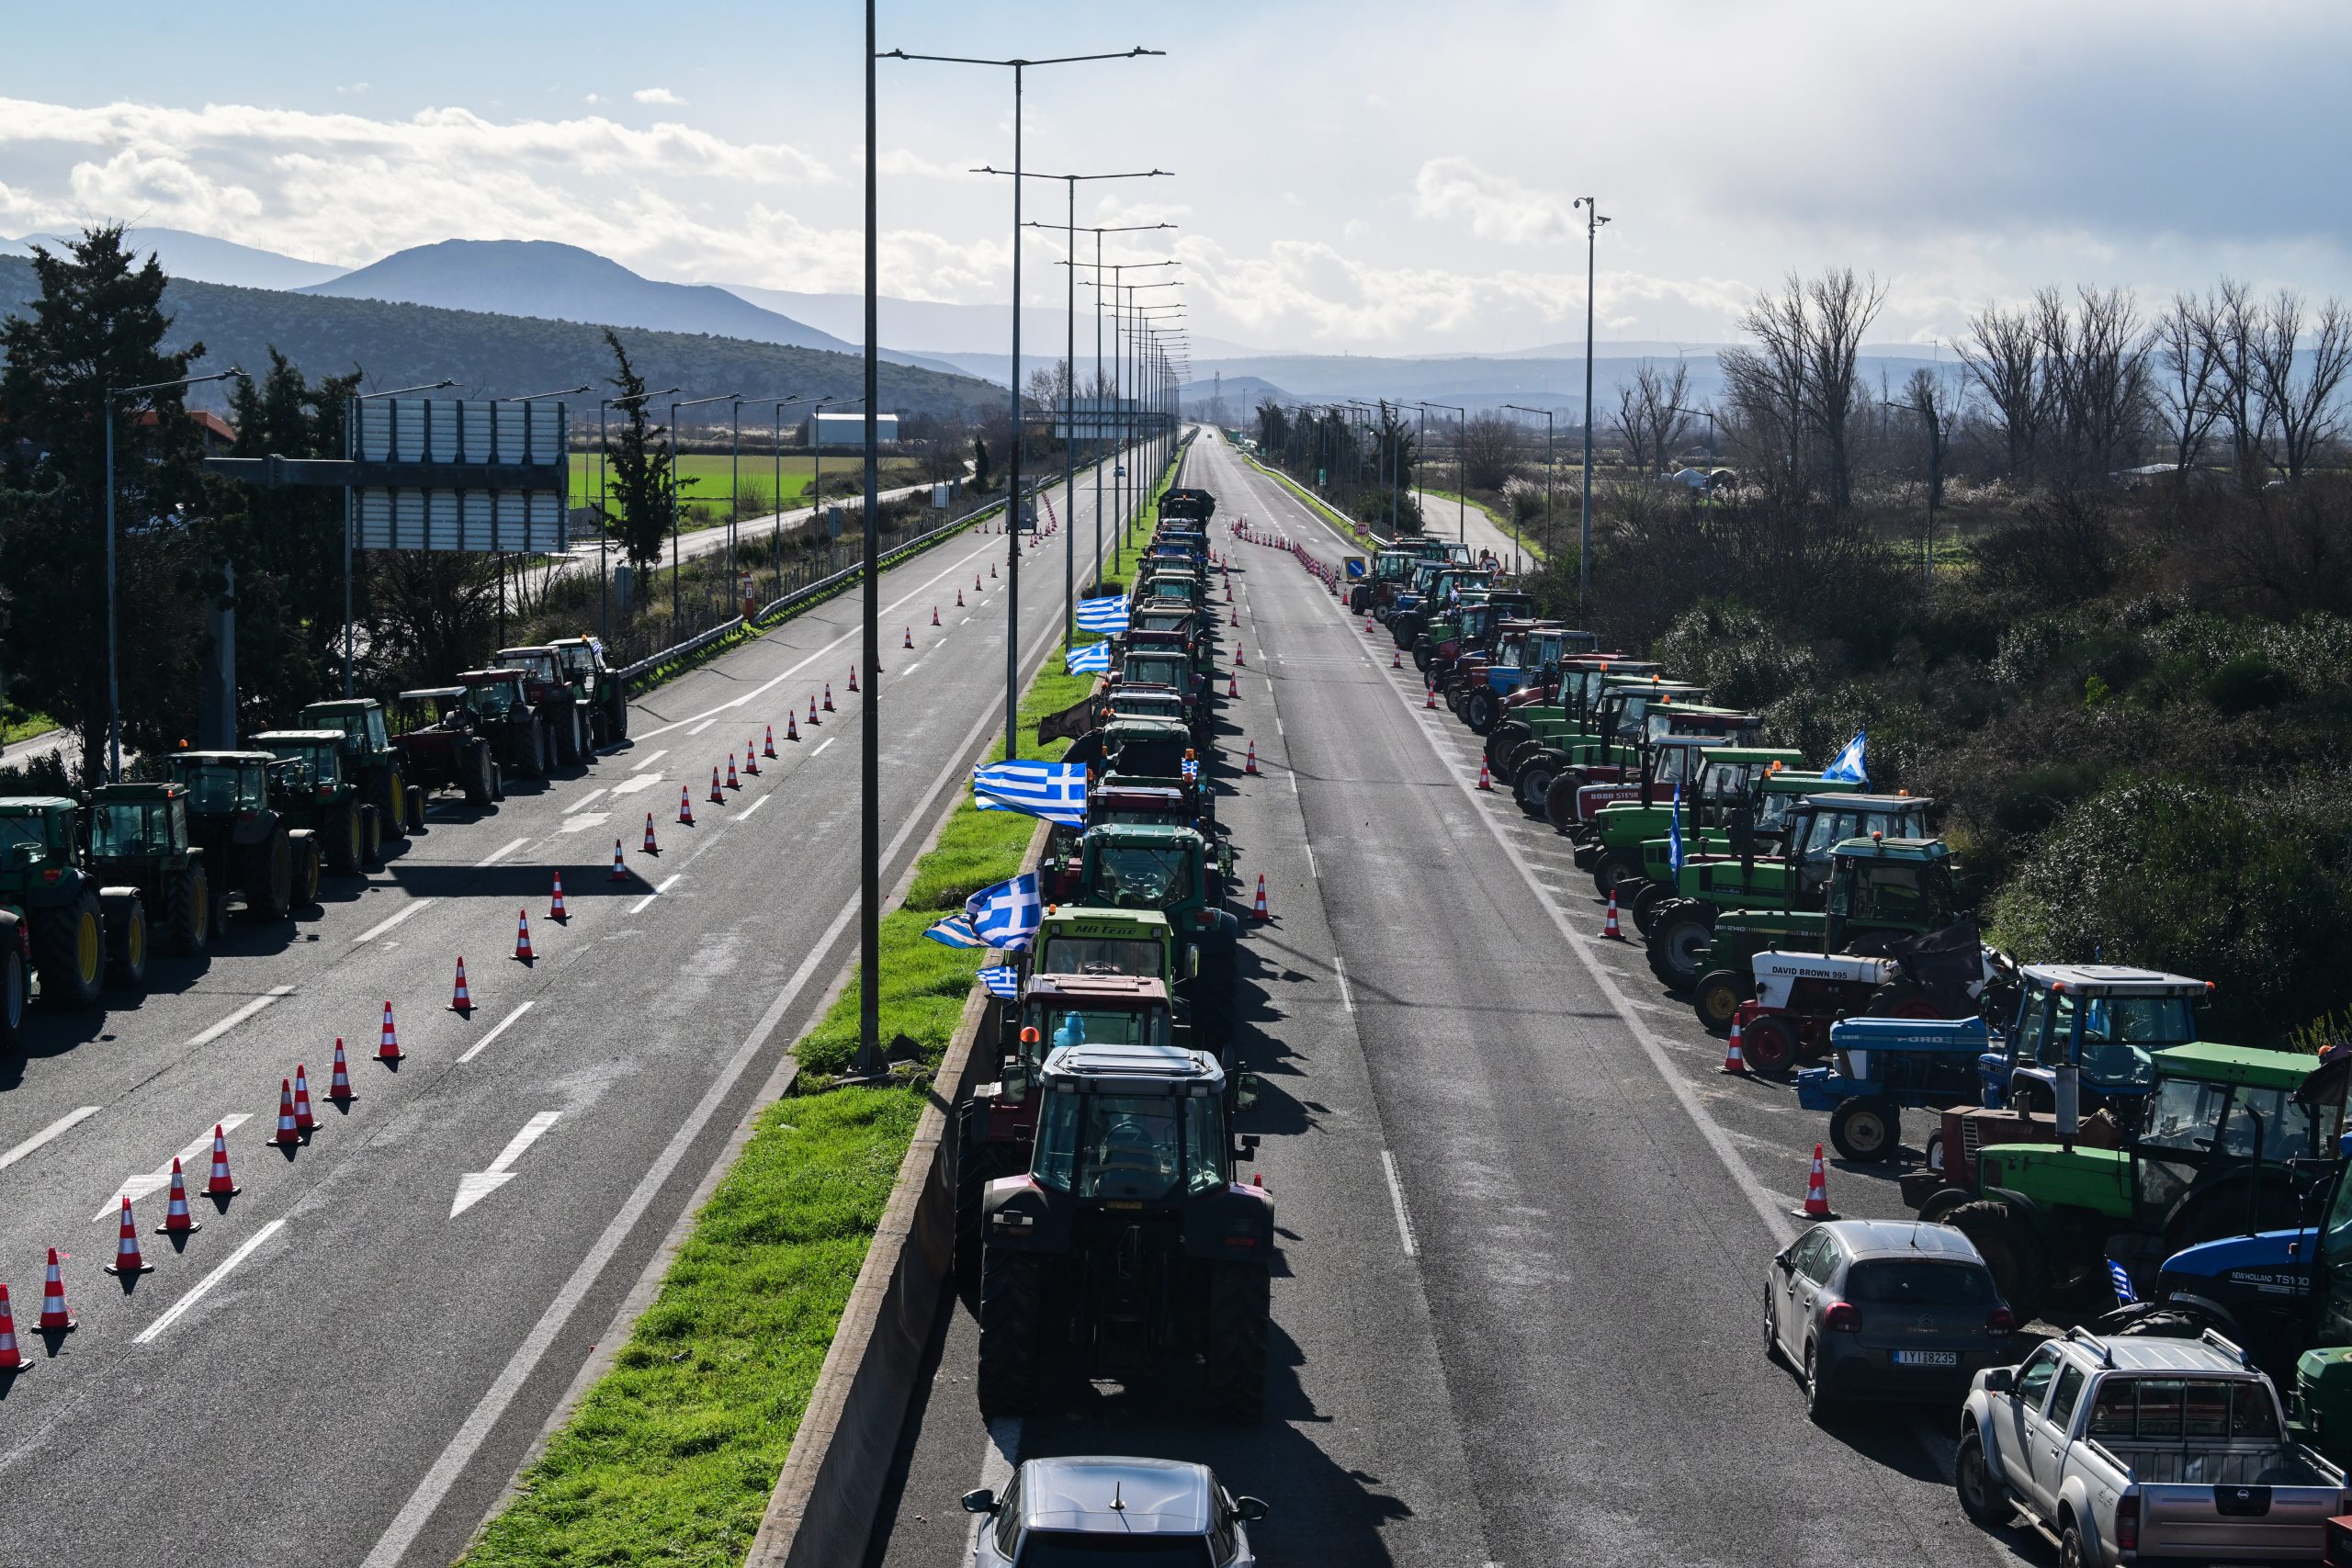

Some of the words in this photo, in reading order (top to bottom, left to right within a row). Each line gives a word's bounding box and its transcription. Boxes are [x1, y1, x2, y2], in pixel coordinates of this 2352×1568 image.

[1357, 525, 1368, 534] STOP
[1075, 925, 1099, 933] MB
[1102, 925, 1137, 935] trac
[1772, 966, 1797, 976] DAVID
[1799, 968, 1830, 978] BROWN
[1832, 971, 1848, 979] 995
[2245, 1273, 2273, 1282] HOLLAND
[1905, 1351, 1921, 1362] IYI
[1928, 1353, 1955, 1364] 8235
